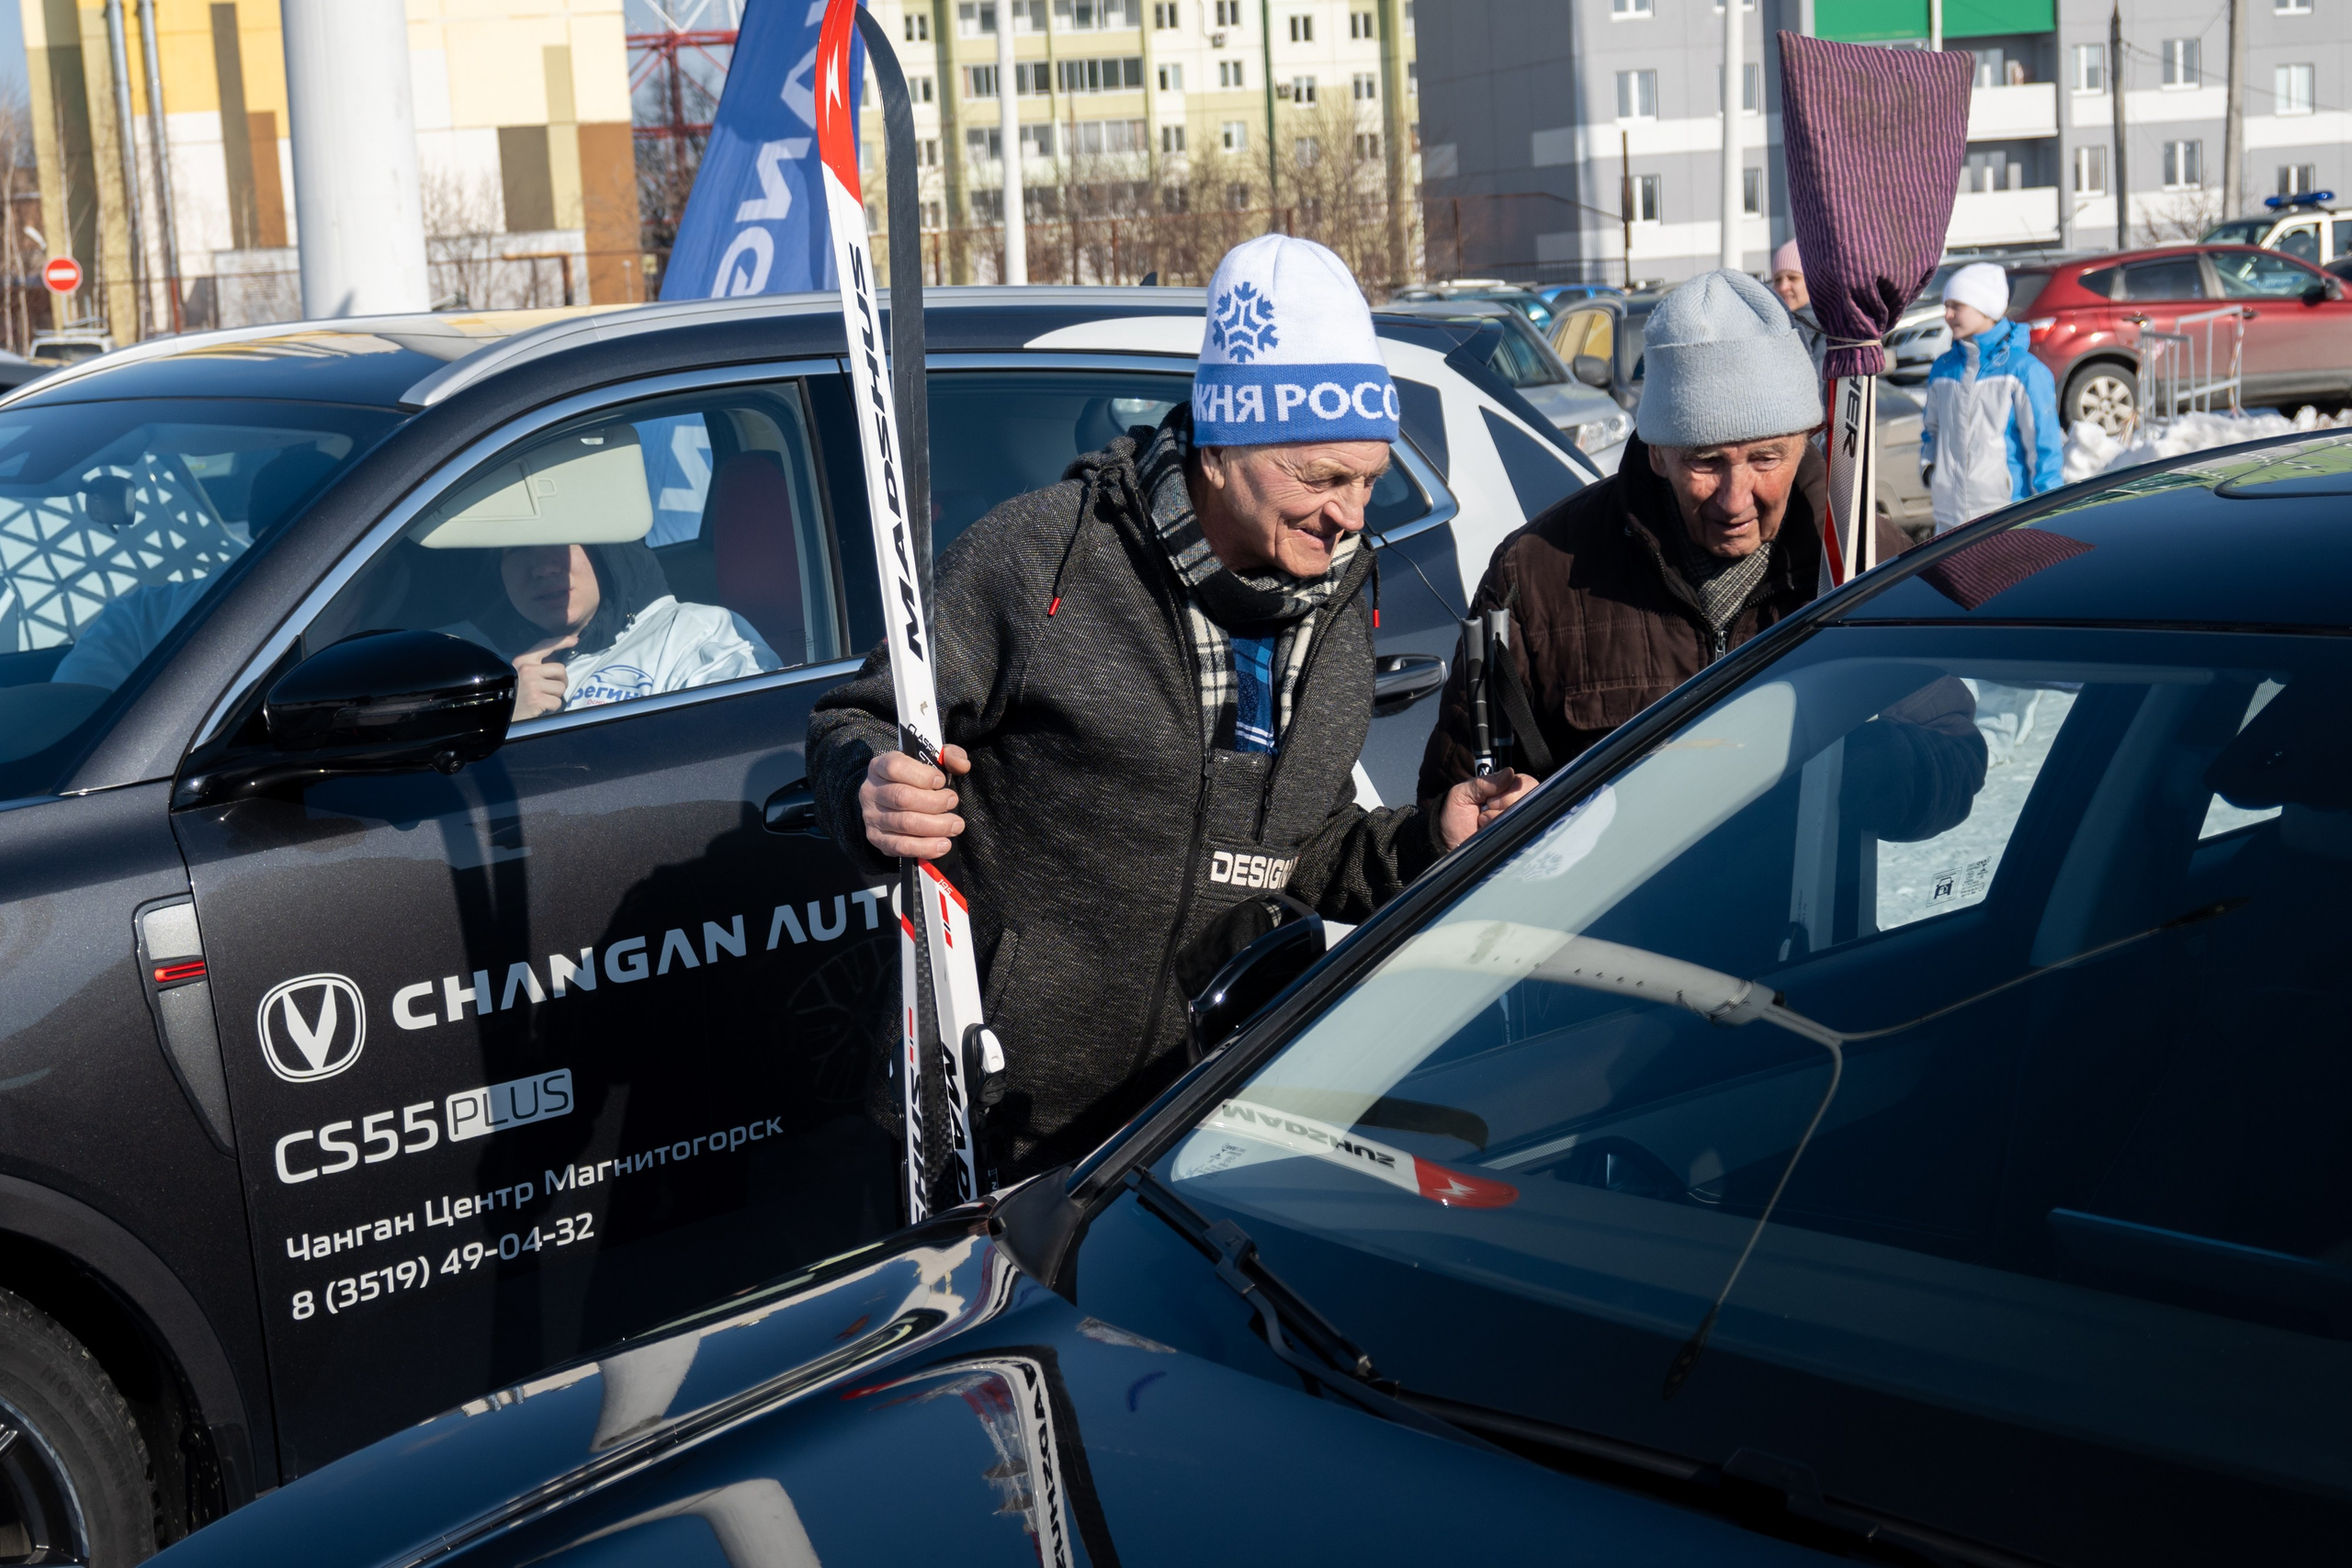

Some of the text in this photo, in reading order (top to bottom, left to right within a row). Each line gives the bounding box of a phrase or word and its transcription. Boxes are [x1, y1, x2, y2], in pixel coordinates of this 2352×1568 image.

[848, 242, 924, 662] MADSHUS
[937, 878, 953, 896] 195
[1210, 851, 1299, 889] DESIGN
[392, 882, 901, 1031] CHANGAN AUT
[276, 1074, 570, 1184] CS55 PLUS
[941, 1041, 971, 1203] MAD
[287, 1116, 784, 1261] Чанган Центр Магнитогорск
[292, 1213, 594, 1320] 8 (3519) 49-04-32
